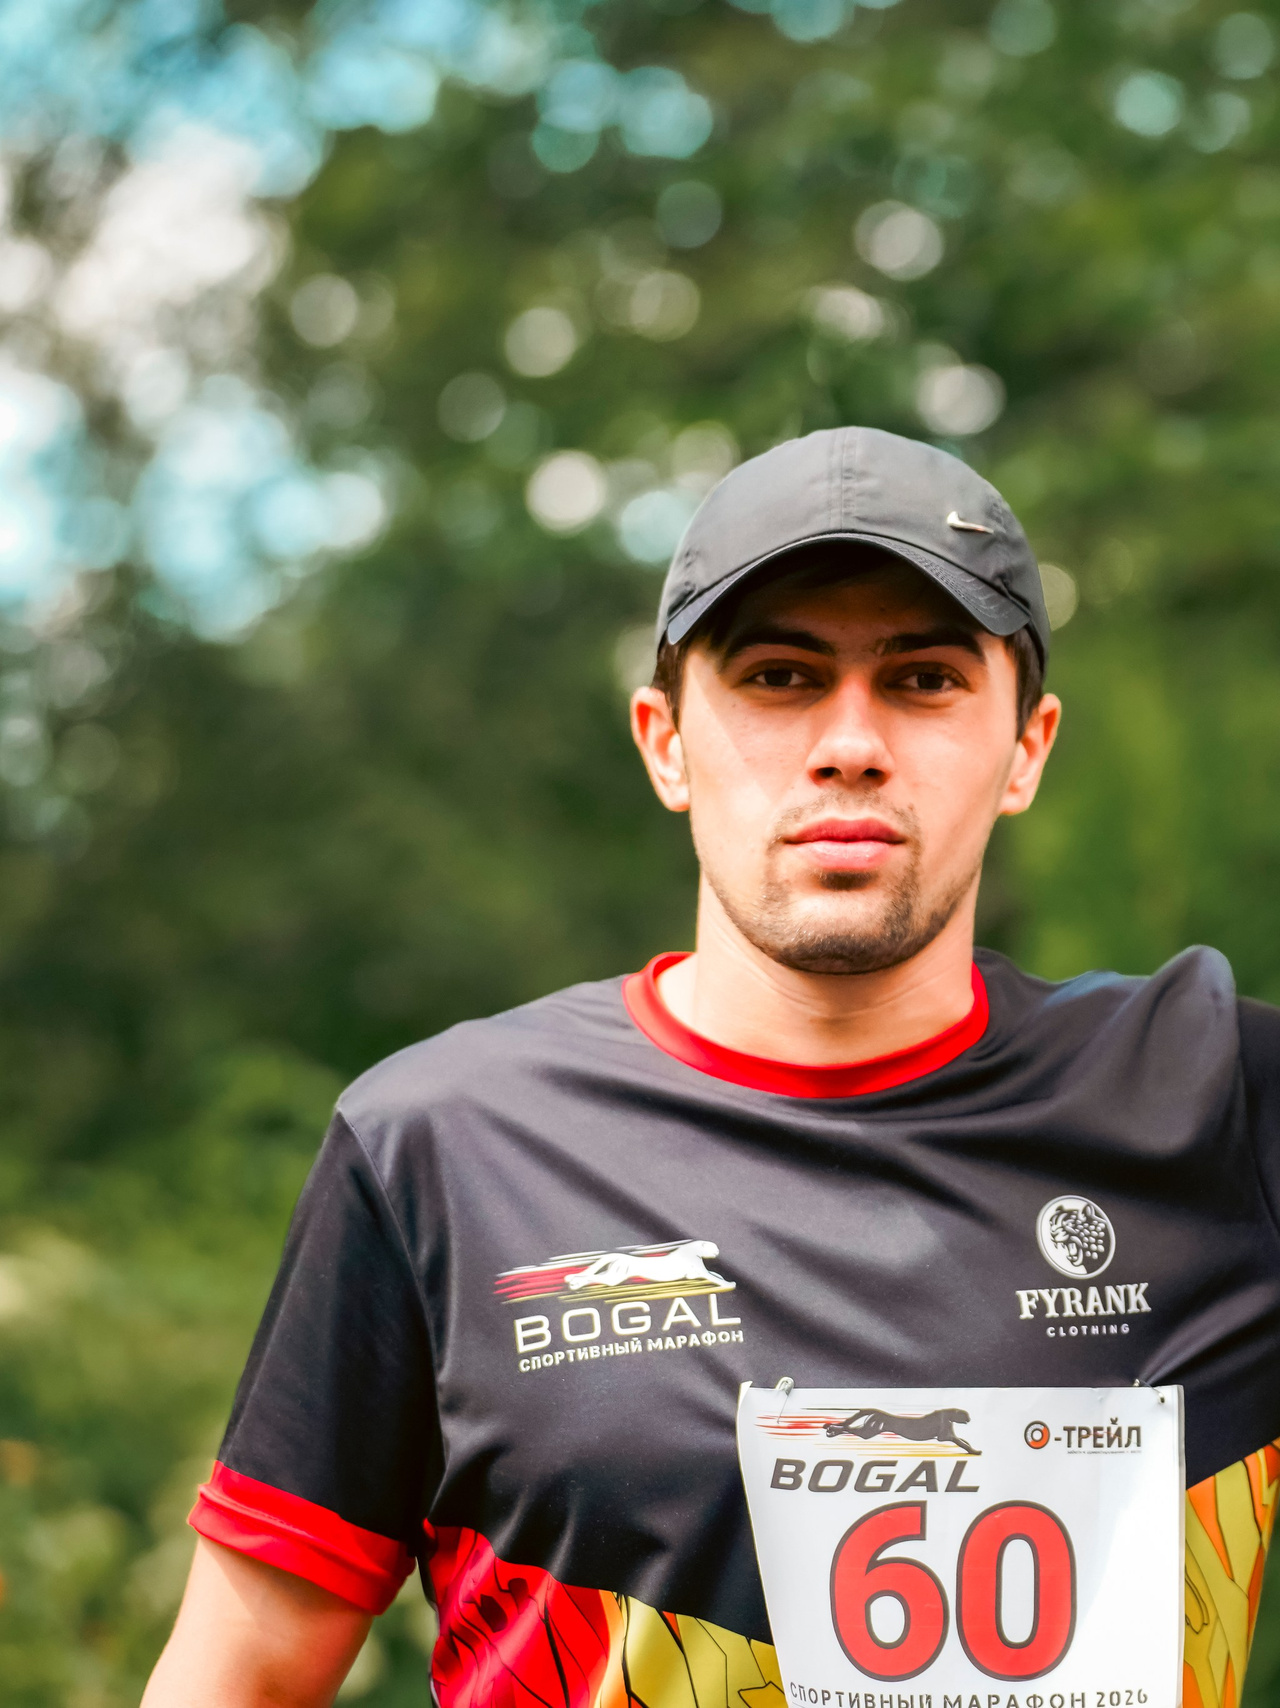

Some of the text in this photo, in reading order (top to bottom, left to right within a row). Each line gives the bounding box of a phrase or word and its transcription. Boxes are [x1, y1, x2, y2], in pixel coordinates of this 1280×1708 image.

[1015, 1282, 1152, 1320] FYRANK
[513, 1293, 742, 1354] BOGAL
[1046, 1323, 1130, 1338] CLOTHING
[518, 1329, 745, 1373] СПОРТИВНЫЙ МАРАФОН
[769, 1457, 981, 1493] BOGAL
[829, 1500, 1077, 1682] 60
[790, 1681, 1149, 1708] СПОРТИВНЫЙ МАРАФОН 2026
